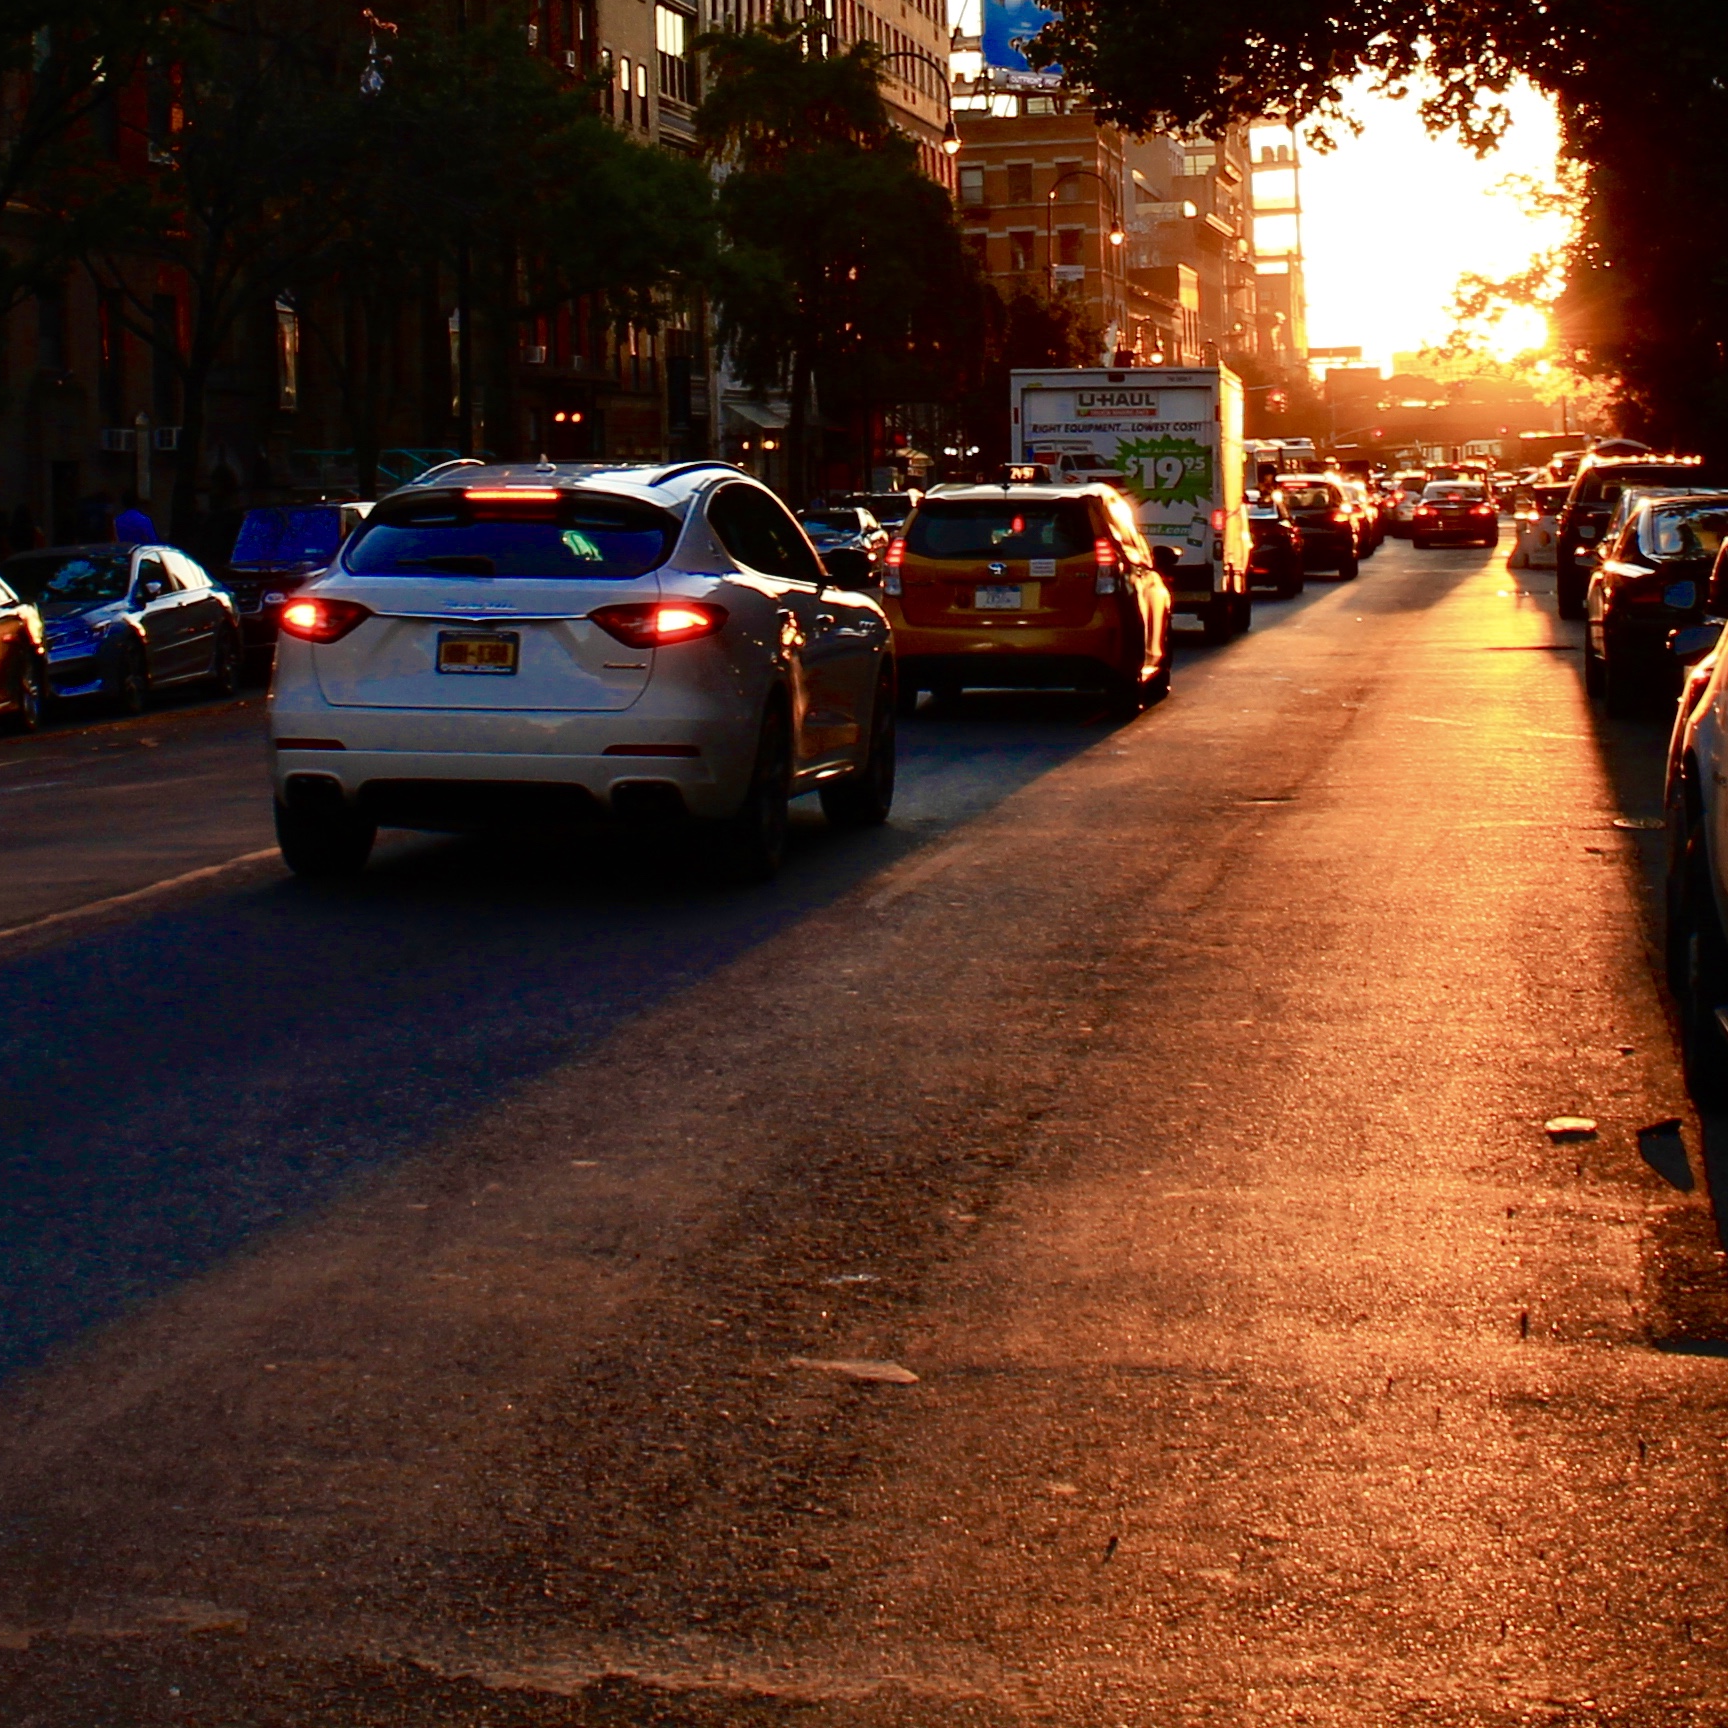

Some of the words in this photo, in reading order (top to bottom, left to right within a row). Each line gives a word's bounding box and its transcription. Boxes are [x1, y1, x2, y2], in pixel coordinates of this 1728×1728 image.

[1032, 424, 1061, 434] RIGHT
[1131, 423, 1170, 433] LOWEST
[1173, 422, 1202, 433] COST!
